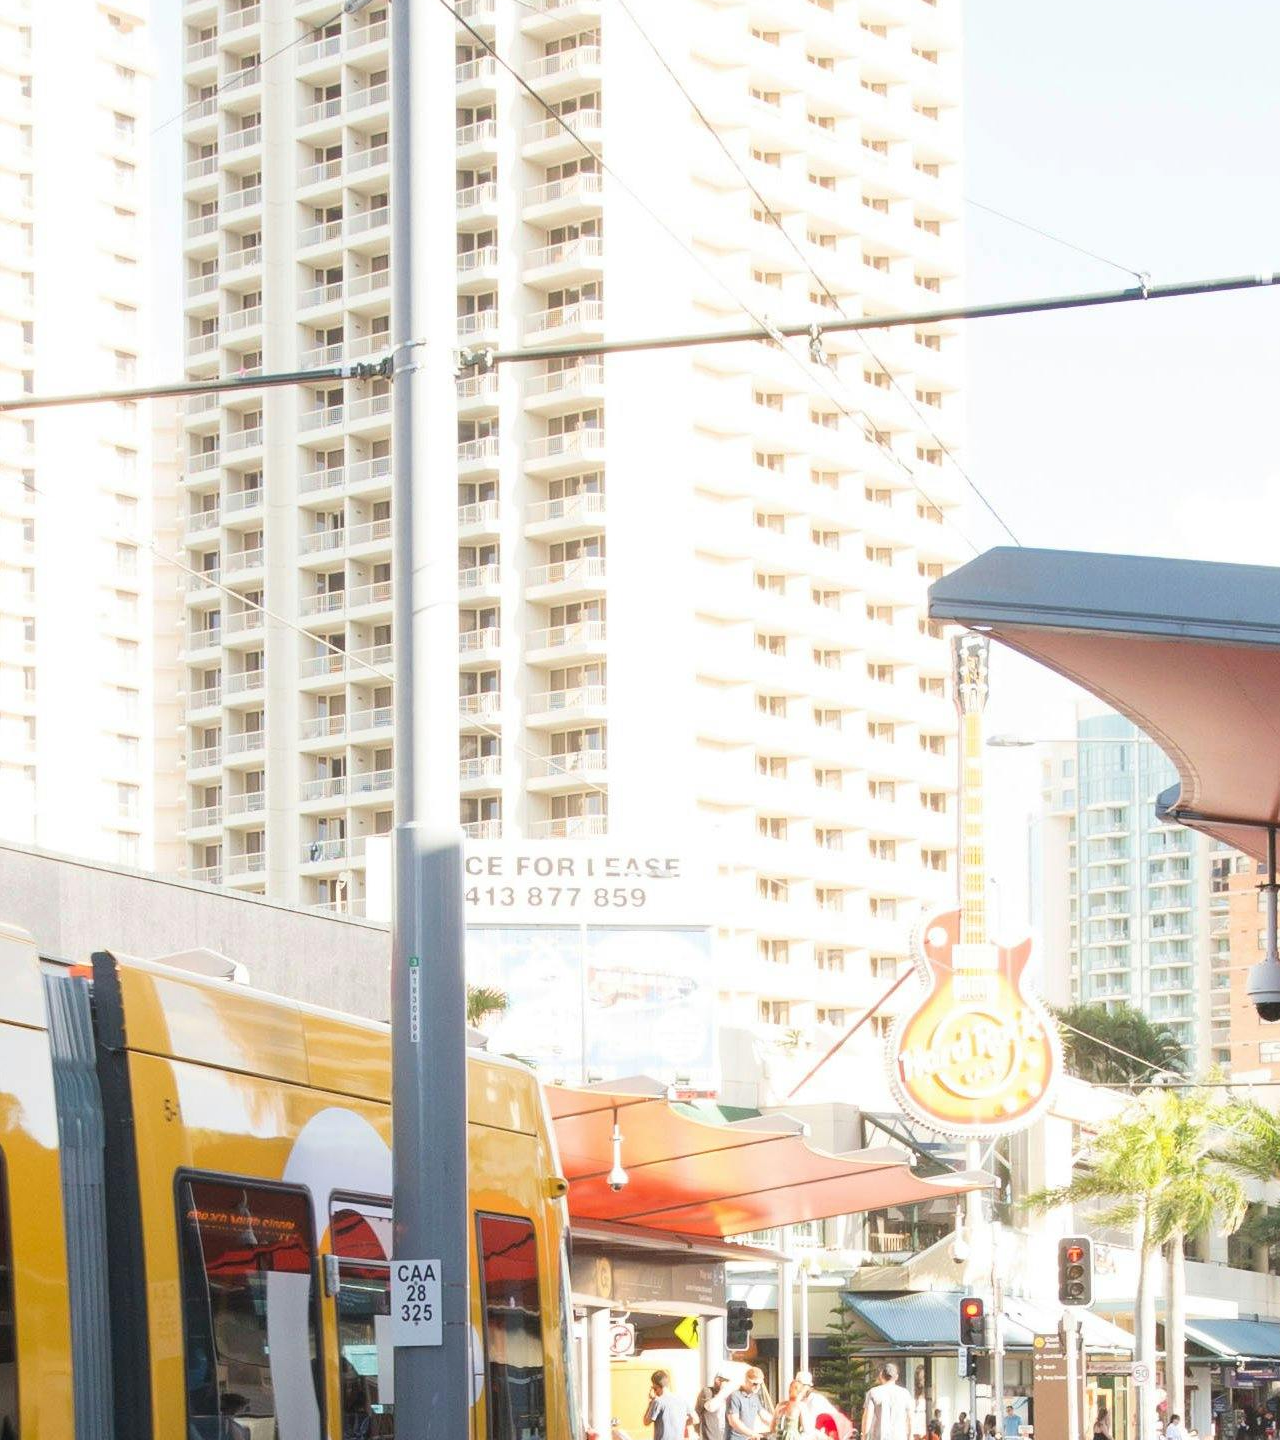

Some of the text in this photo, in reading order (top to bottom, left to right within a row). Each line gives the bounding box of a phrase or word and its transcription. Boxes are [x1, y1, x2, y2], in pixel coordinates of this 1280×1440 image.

[516, 856, 575, 877] FOR
[464, 886, 647, 908] 413 877 859
[397, 1264, 436, 1283] CAA
[406, 1284, 427, 1302] 28
[401, 1304, 433, 1322] 325
[1135, 1368, 1149, 1379] 50
